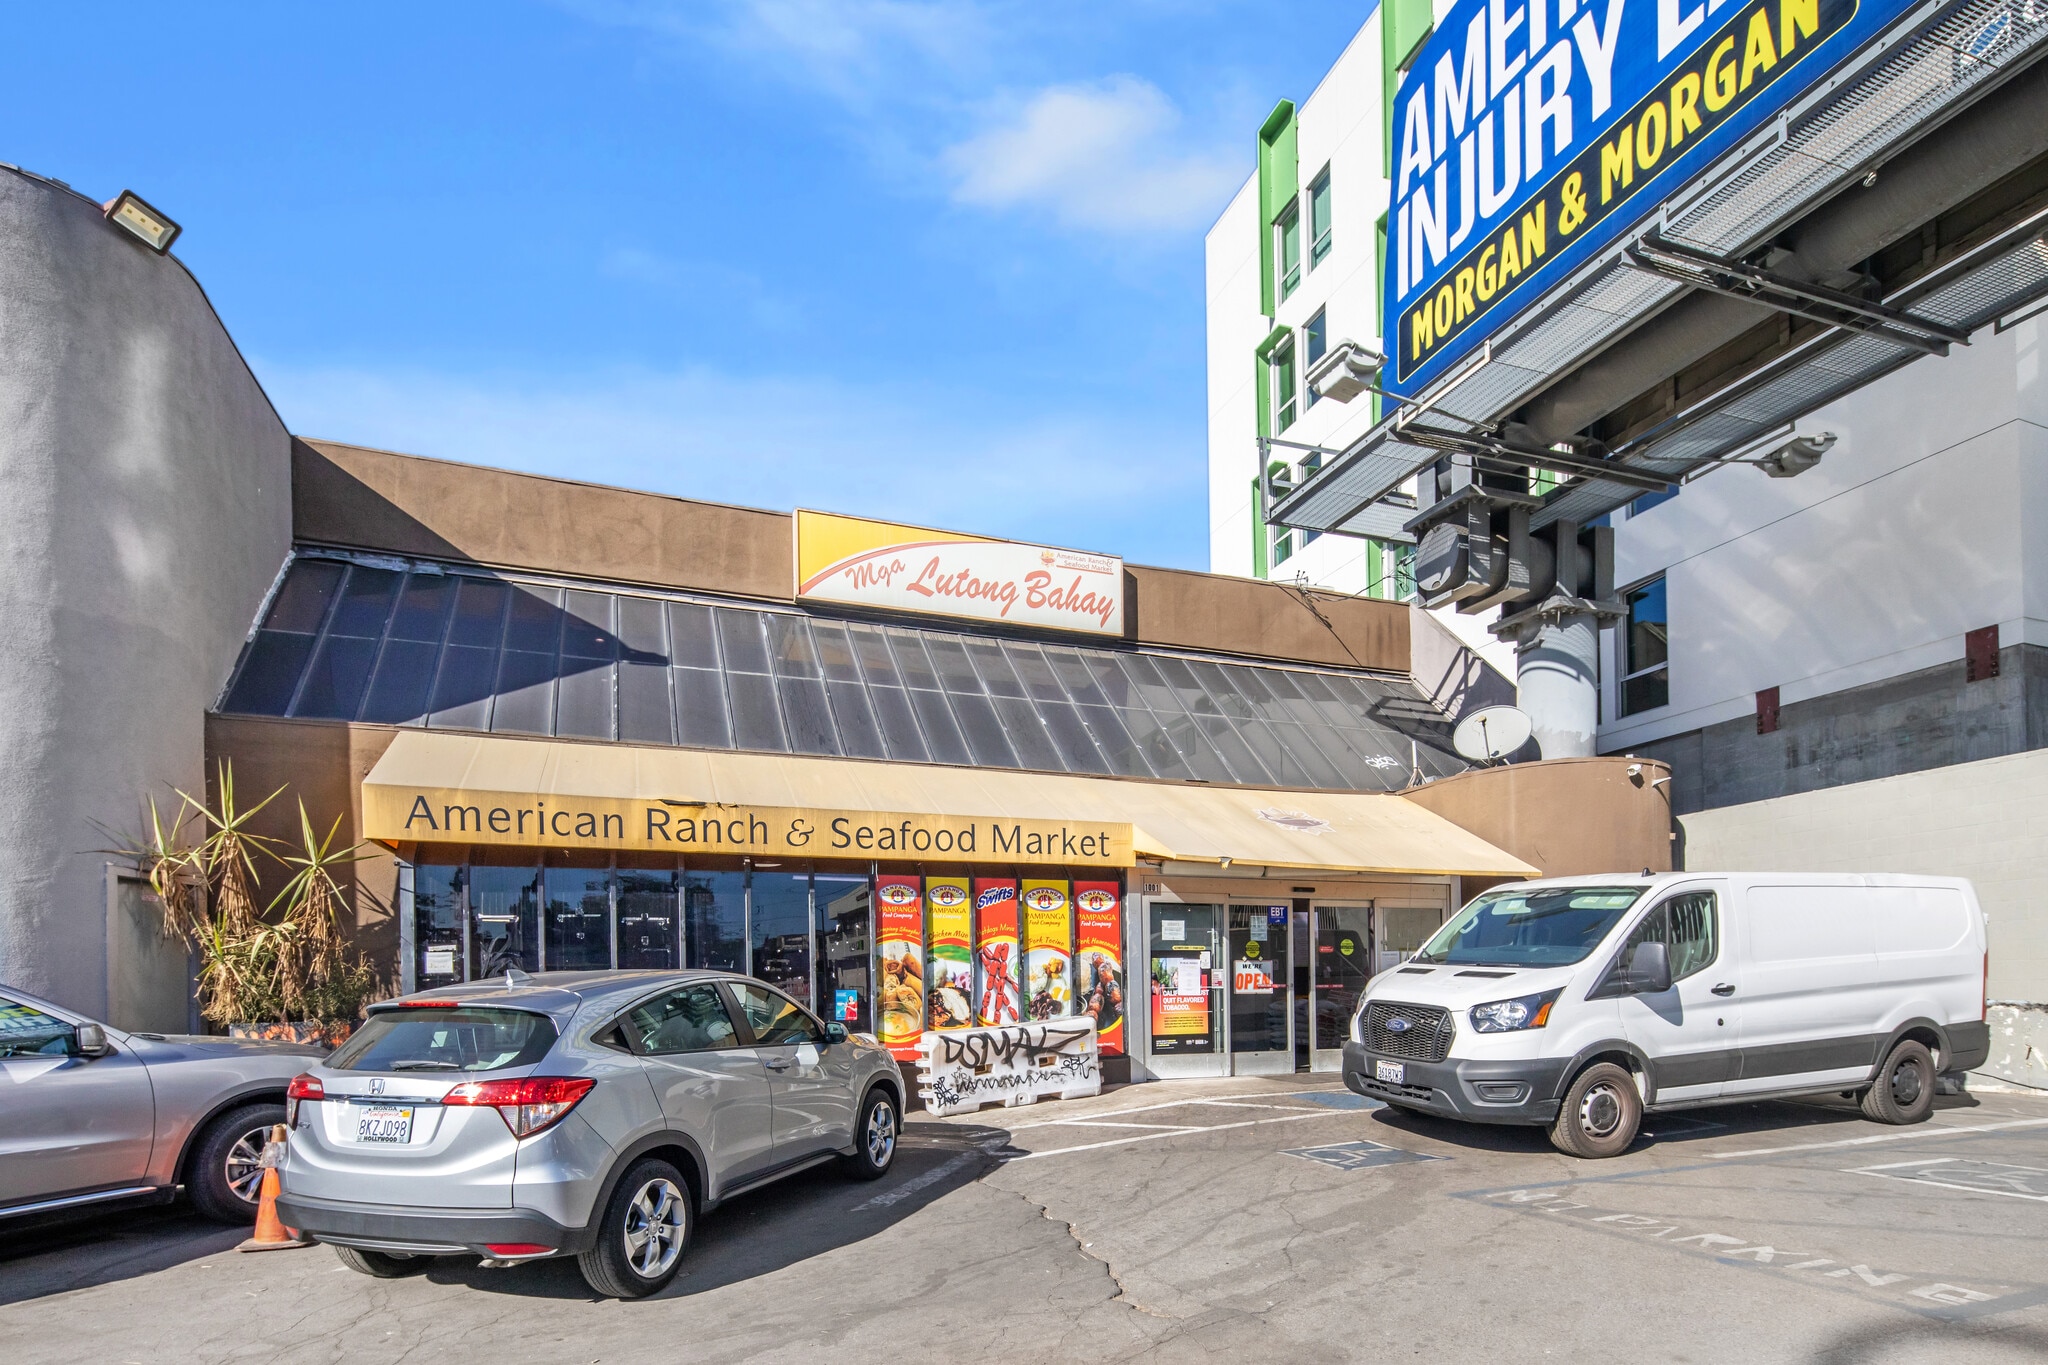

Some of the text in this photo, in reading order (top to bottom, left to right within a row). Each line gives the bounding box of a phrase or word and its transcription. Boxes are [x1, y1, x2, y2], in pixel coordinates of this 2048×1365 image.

[1398, 0, 1626, 303] INJURY
[1412, 0, 1820, 362] MORGAN & MORGAN
[844, 555, 1116, 629] Mga Lutong Bahay
[404, 794, 1111, 858] American Ranch & Seafood Market
[1024, 912, 1066, 920] PAMPANGA
[1077, 913, 1117, 921] PAMPANGA
[1270, 907, 1285, 917] EBT
[1235, 972, 1271, 991] OPEN
[368, 1110, 401, 1120] California
[358, 1119, 408, 1137] 8KZJ098
